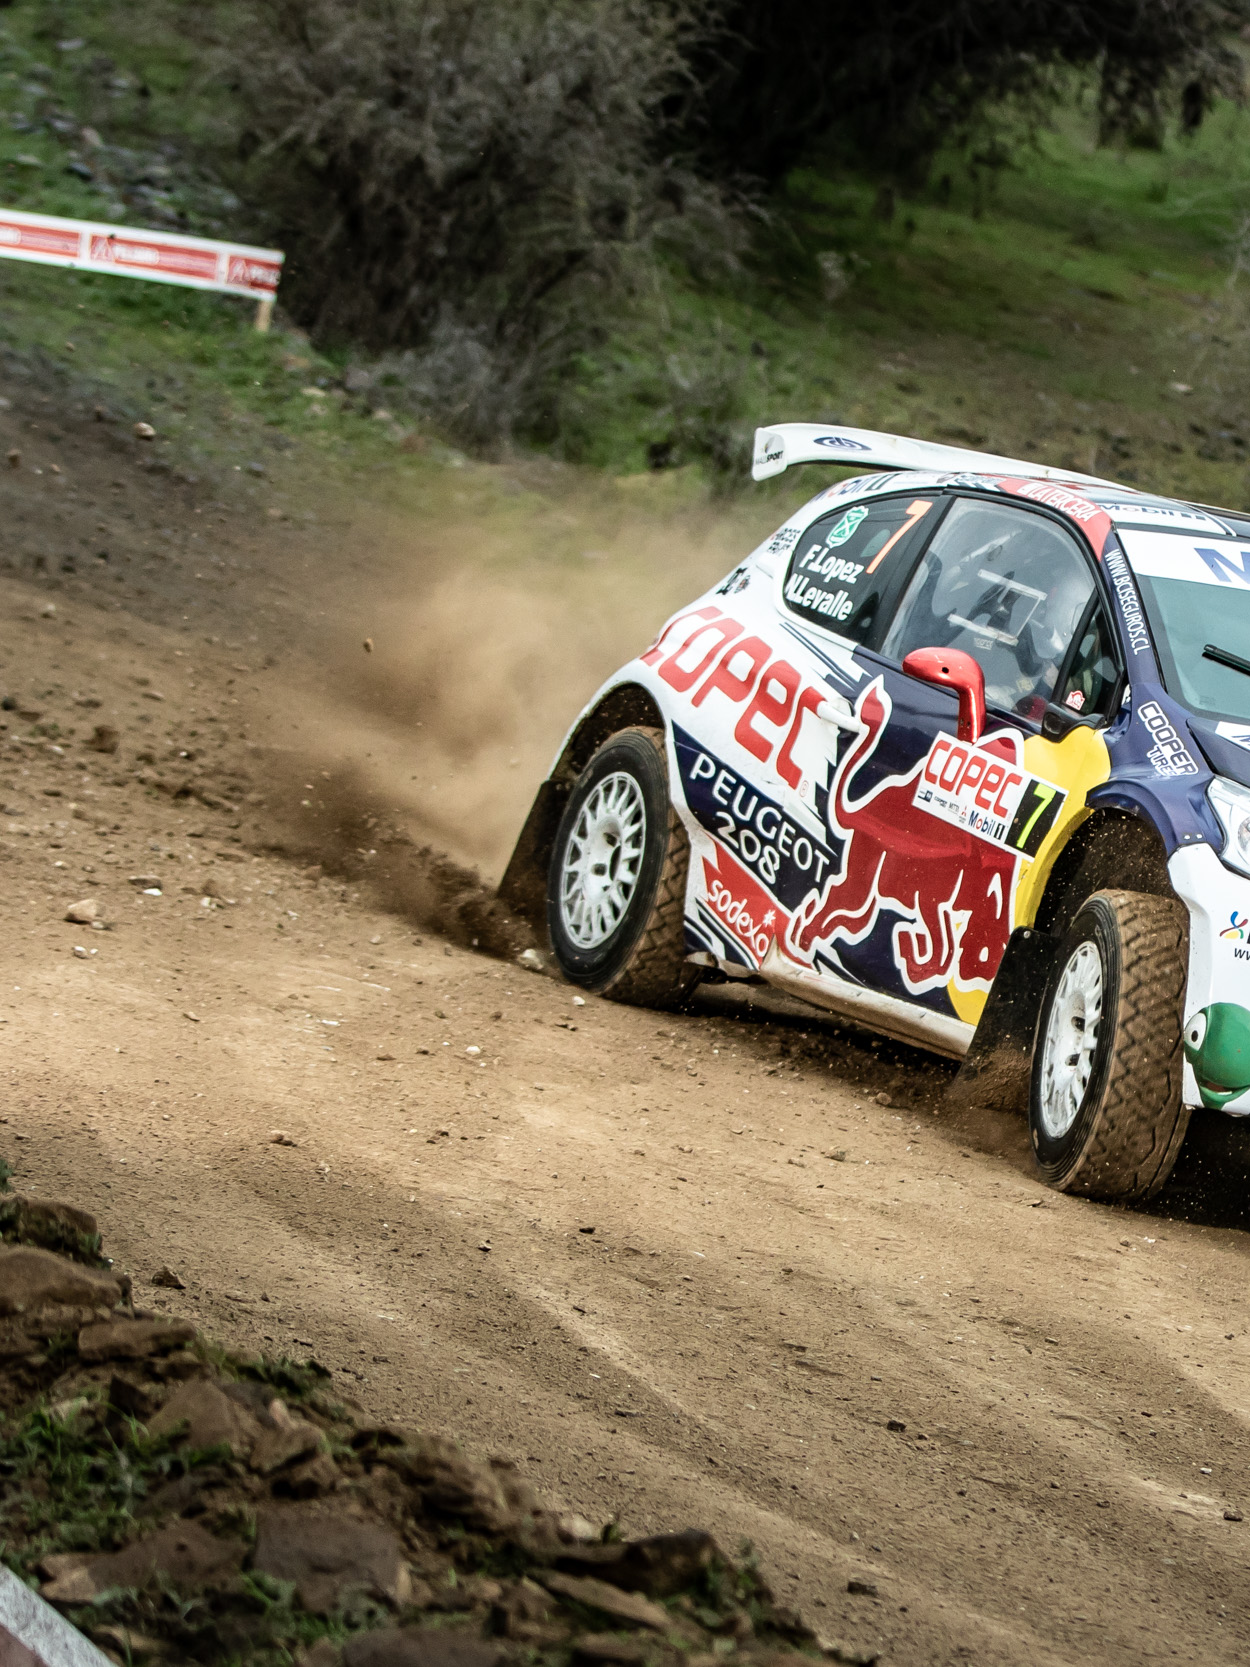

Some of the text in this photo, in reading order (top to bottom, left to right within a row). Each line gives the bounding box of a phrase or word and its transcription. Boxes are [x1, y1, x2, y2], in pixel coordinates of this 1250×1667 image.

[1104, 548, 1150, 655] WWW.BCISEGUROS.CL
[1139, 702, 1198, 774] COOPER
[690, 753, 829, 882] PEUGEOT
[716, 812, 780, 885] 208
[968, 810, 996, 836] Mobil
[1016, 783, 1057, 849] 7
[708, 880, 769, 957] sodexo
